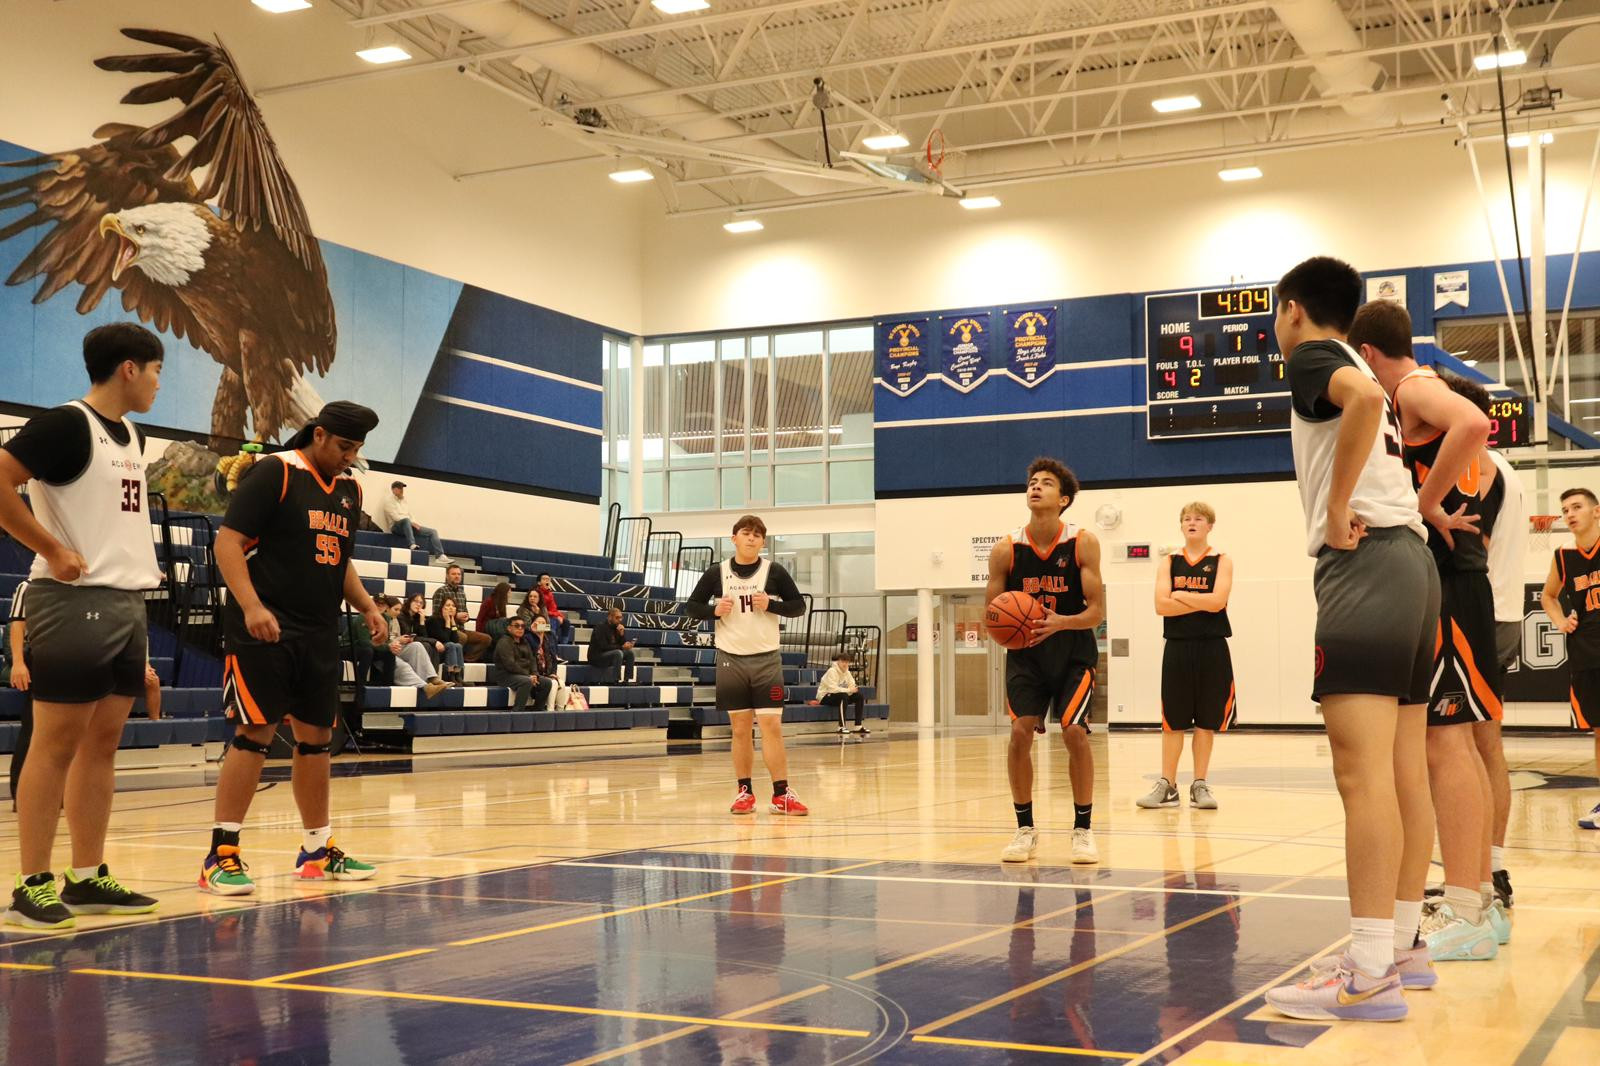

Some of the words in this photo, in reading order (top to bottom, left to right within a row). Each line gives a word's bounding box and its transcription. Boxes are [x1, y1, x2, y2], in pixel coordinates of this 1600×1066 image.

[1217, 289, 1268, 313] 4:04
[1160, 322, 1191, 335] HOME
[1222, 323, 1249, 333] PERIOD
[1014, 340, 1047, 348] CHAMPIONS
[1179, 335, 1194, 357] 9
[1237, 335, 1242, 351] 1
[1156, 361, 1179, 370] FOULS
[1186, 360, 1206, 368] T.O.L.
[1213, 357, 1241, 366] PLAYER
[1242, 355, 1261, 364] FOUL
[1189, 368, 1201, 387] 2
[1279, 363, 1284, 379] 1
[1164, 371, 1176, 387] 4
[1156, 391, 1180, 400] SCORE
[1224, 386, 1250, 394] MATCH
[1169, 407, 1173, 415] 1
[1257, 401, 1262, 409] 3
[121, 478, 141, 513] 33
[308, 509, 350, 538] BB4ALL
[972, 536, 1004, 544] SPECTAT
[315, 533, 341, 566] 55
[1022, 575, 1069, 593] BB4ALL
[1174, 576, 1209, 590] BB4ALL
[739, 594, 753, 614] 14
[1521, 610, 1569, 671] G
